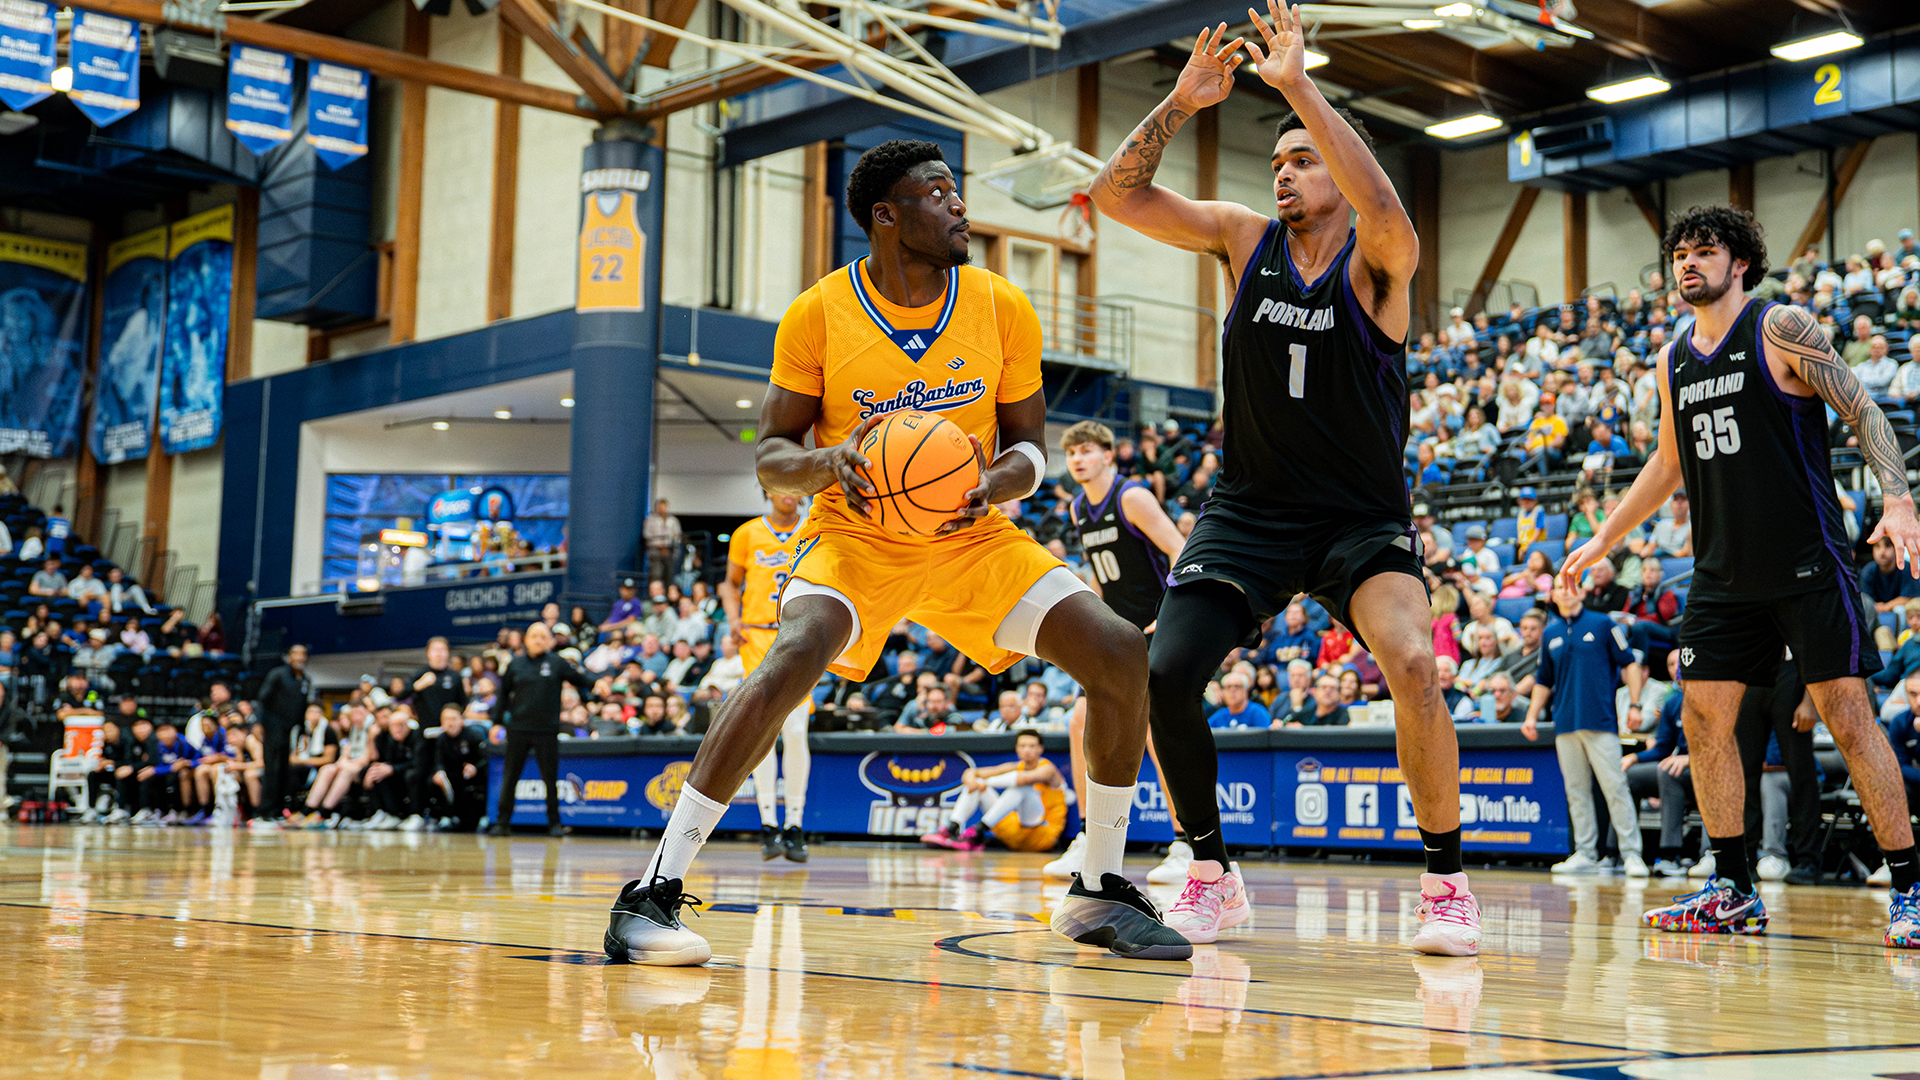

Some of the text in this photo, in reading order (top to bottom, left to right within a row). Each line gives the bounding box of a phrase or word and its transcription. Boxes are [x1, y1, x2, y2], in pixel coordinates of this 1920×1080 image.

[1814, 63, 1842, 105] 2
[1515, 129, 1531, 167] 1
[590, 254, 624, 283] 22
[1288, 342, 1308, 399] 1
[1729, 351, 1746, 362] WCC
[1678, 371, 1746, 412] PORTLAND
[1691, 405, 1742, 461] 35
[1091, 549, 1121, 585] 10
[513, 580, 554, 606] SHOP
[583, 780, 628, 801] SHOP
[1473, 767, 1504, 785] SOCIAL
[1504, 767, 1534, 785] MEDIA
[1476, 794, 1541, 823] YouTube
